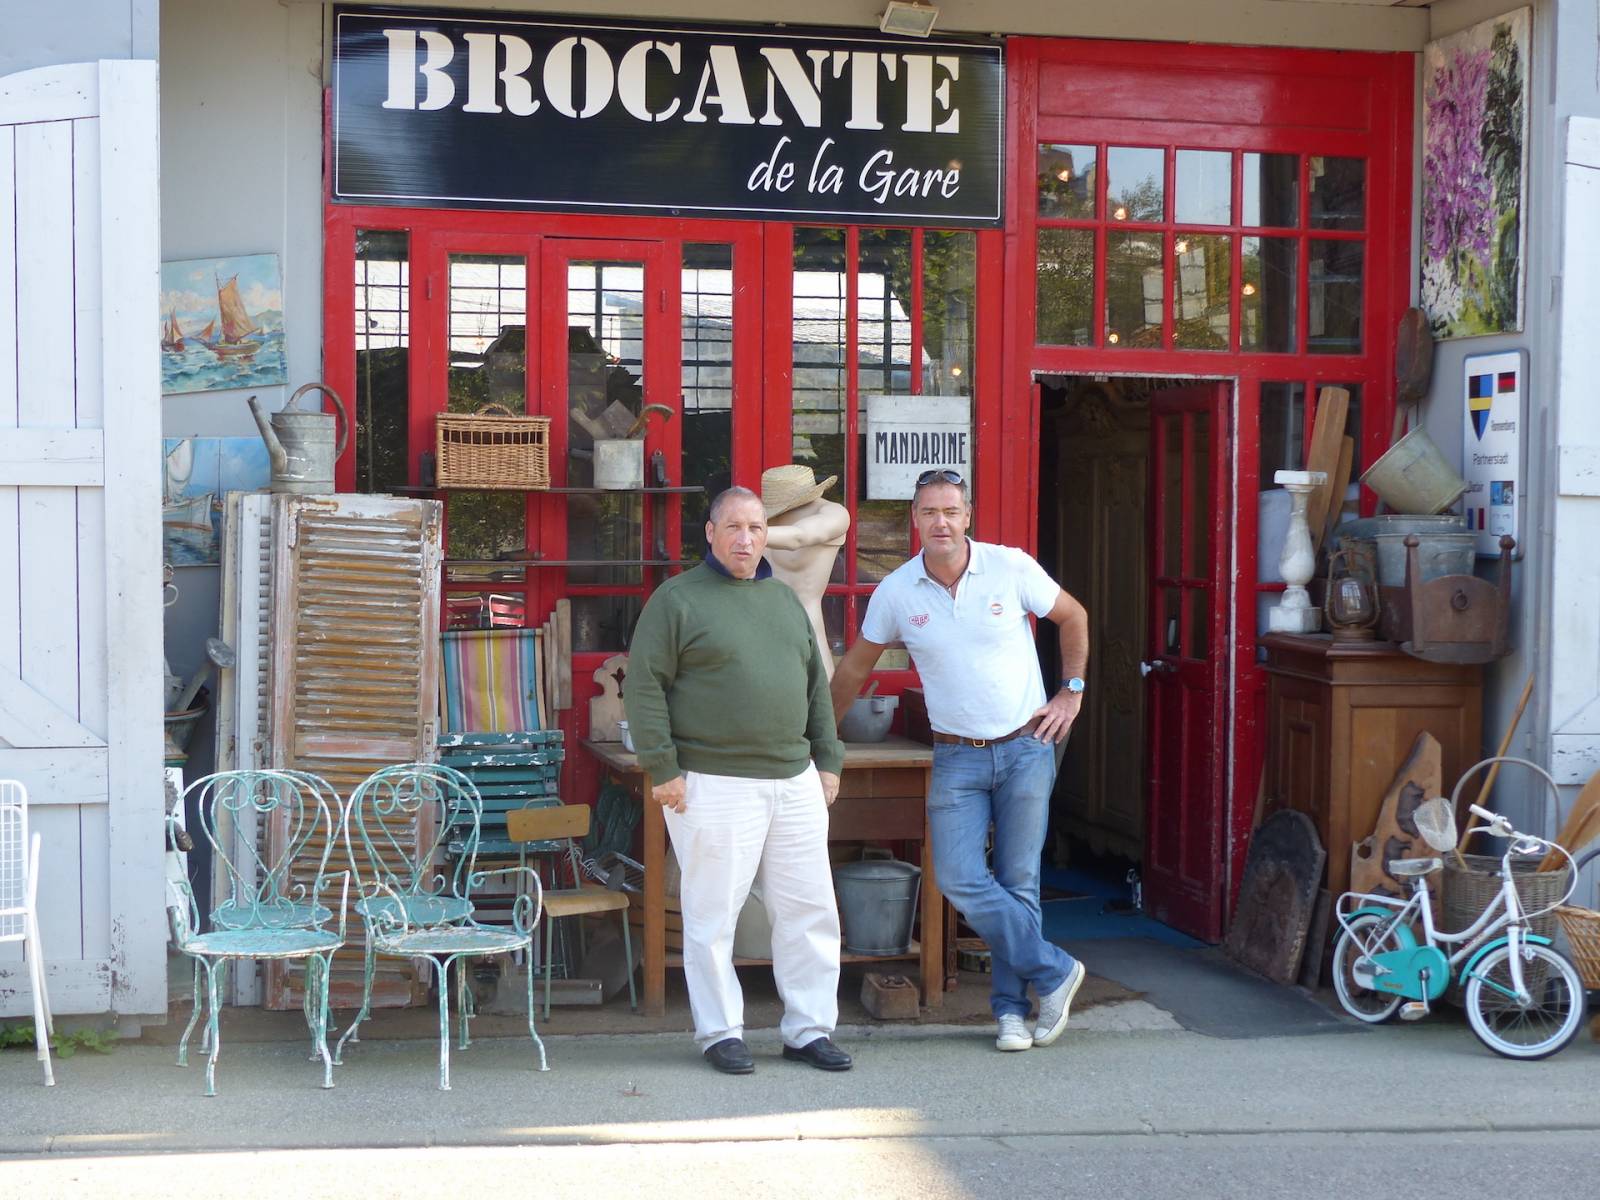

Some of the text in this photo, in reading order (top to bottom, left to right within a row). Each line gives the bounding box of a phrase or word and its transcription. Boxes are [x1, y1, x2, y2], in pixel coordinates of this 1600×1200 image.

[381, 28, 960, 134] BROCANTE
[747, 135, 961, 204] de la Gare
[875, 432, 967, 465] MANDARINE
[1472, 451, 1509, 465] Partnerstadt
